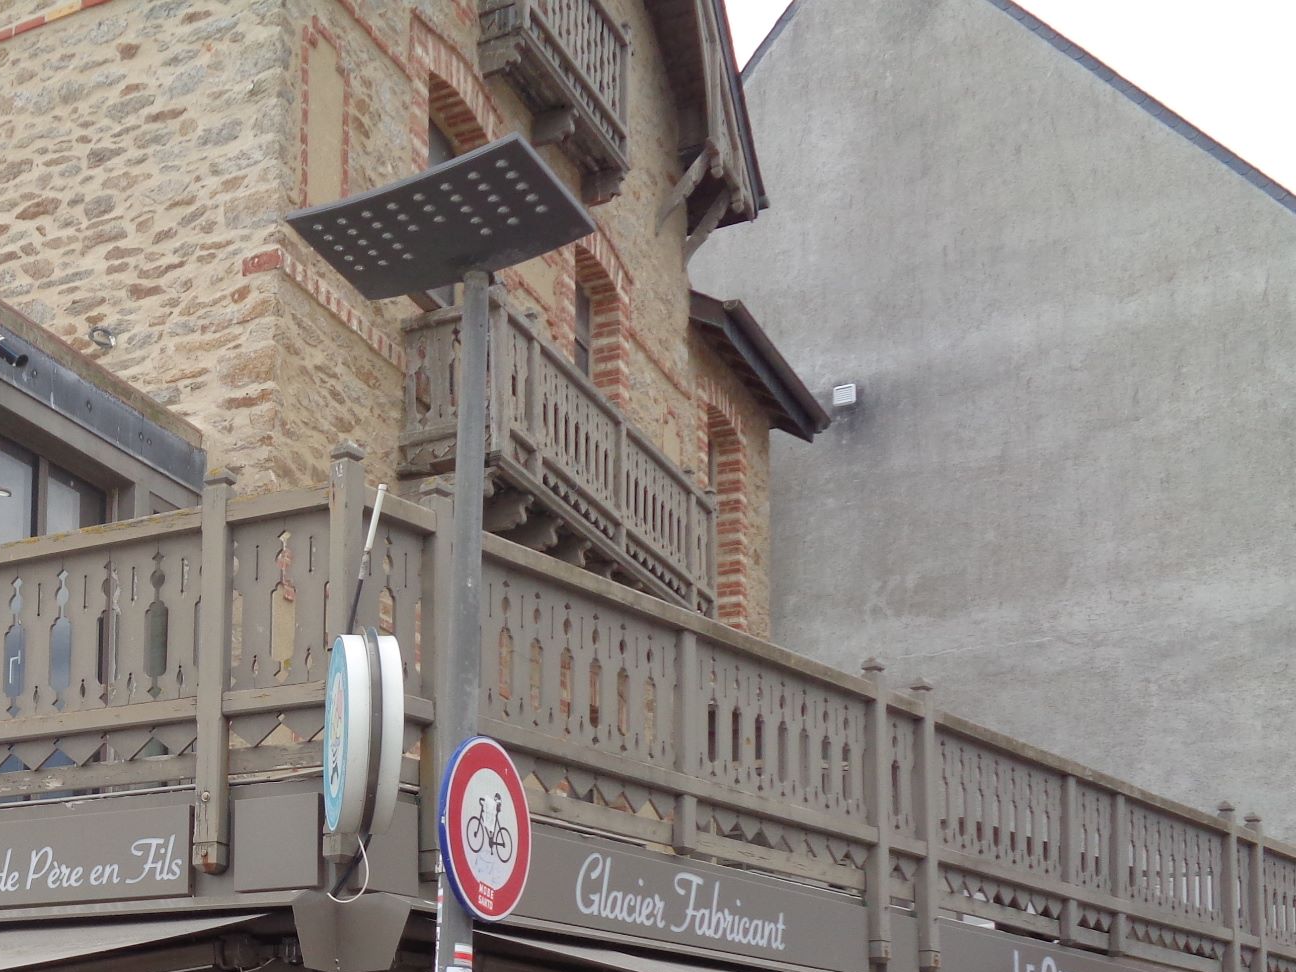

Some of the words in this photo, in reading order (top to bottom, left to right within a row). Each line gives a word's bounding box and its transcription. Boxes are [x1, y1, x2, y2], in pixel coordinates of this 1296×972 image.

[25, 846, 84, 890] Père
[89, 862, 121, 887] en
[125, 834, 183, 884] Fils
[575, 852, 666, 929] Glacier
[670, 872, 787, 951] Fabricant
